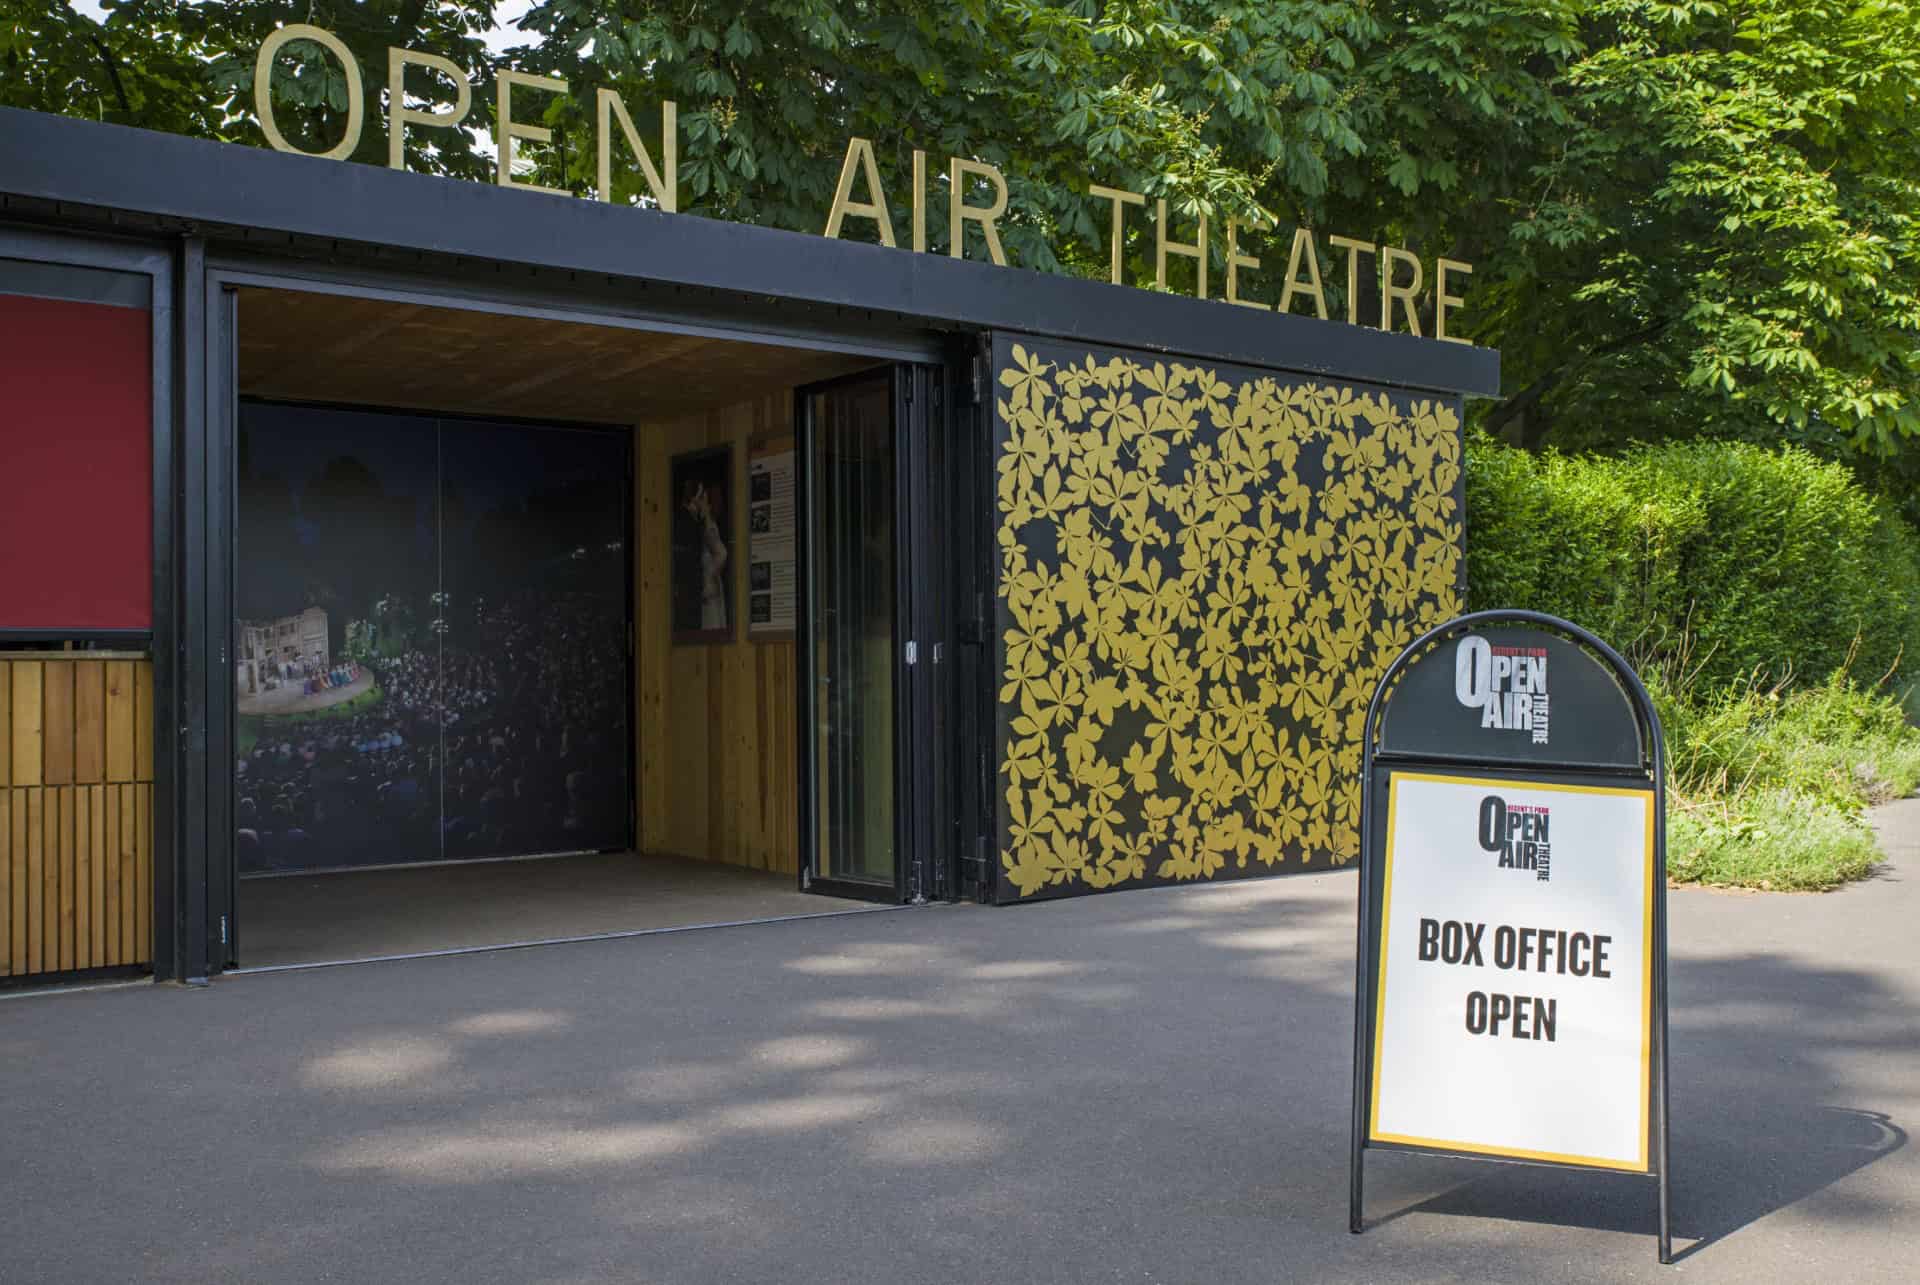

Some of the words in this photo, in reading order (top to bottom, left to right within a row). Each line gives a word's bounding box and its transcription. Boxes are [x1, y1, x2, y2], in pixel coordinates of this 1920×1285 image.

[254, 24, 677, 213] OPEN
[824, 136, 1008, 266] AIR
[1089, 184, 1473, 345] THEATRE
[1456, 635, 1547, 708] OPEN
[1481, 692, 1534, 730] AIR
[1532, 694, 1549, 744] THEATRE
[1479, 795, 1549, 852] OPEN
[1498, 841, 1538, 870] AIR
[1537, 844, 1551, 881] THEATRE
[1418, 918, 1486, 967] BOX
[1494, 925, 1612, 979] OFFICE
[1465, 991, 1557, 1042] OPEN
